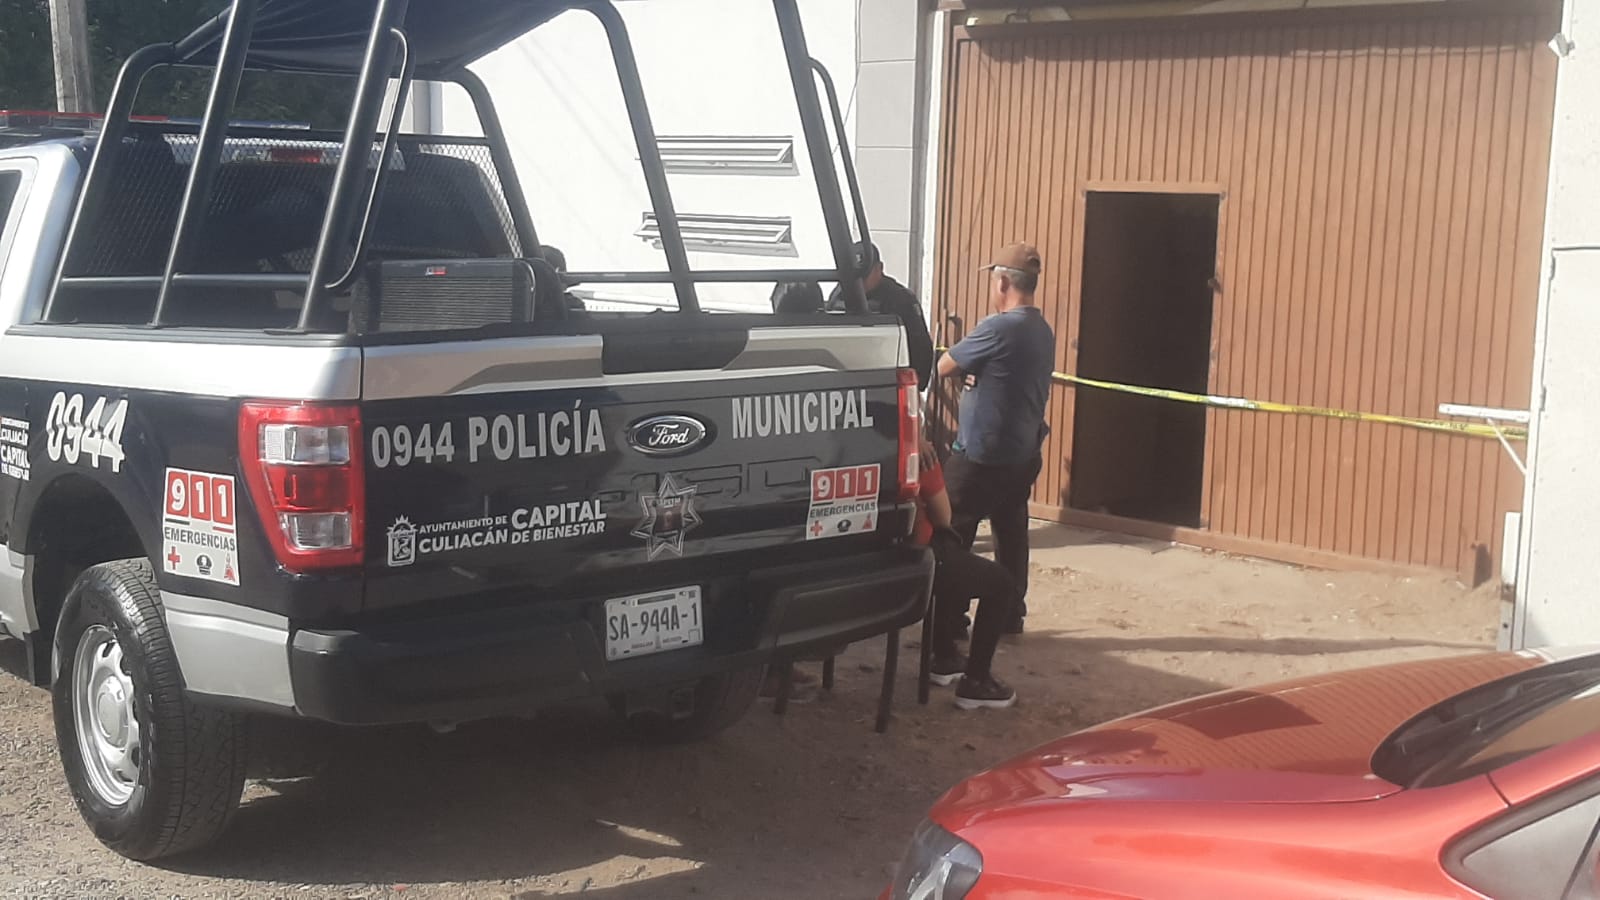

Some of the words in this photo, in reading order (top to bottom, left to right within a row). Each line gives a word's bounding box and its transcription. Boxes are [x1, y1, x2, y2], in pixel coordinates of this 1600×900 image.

[731, 389, 874, 439] MUNICIPAL
[46, 391, 129, 473] 0944
[371, 421, 455, 468] 0944
[468, 399, 606, 463] POLICÍA
[648, 423, 690, 446] Ford
[171, 477, 228, 519] 911
[814, 469, 875, 499] 911
[419, 517, 494, 534] AYUNTAMIENTO
[495, 514, 508, 525] DE
[511, 499, 607, 530] CAPITAL
[809, 502, 877, 518] EMERGENCIAS
[164, 526, 236, 551] EMERGENCIAS
[419, 526, 508, 553] CULIACÁN
[511, 530, 530, 545] DE
[533, 521, 605, 541] BIENESTAR
[609, 602, 698, 641] SA-944A-1
